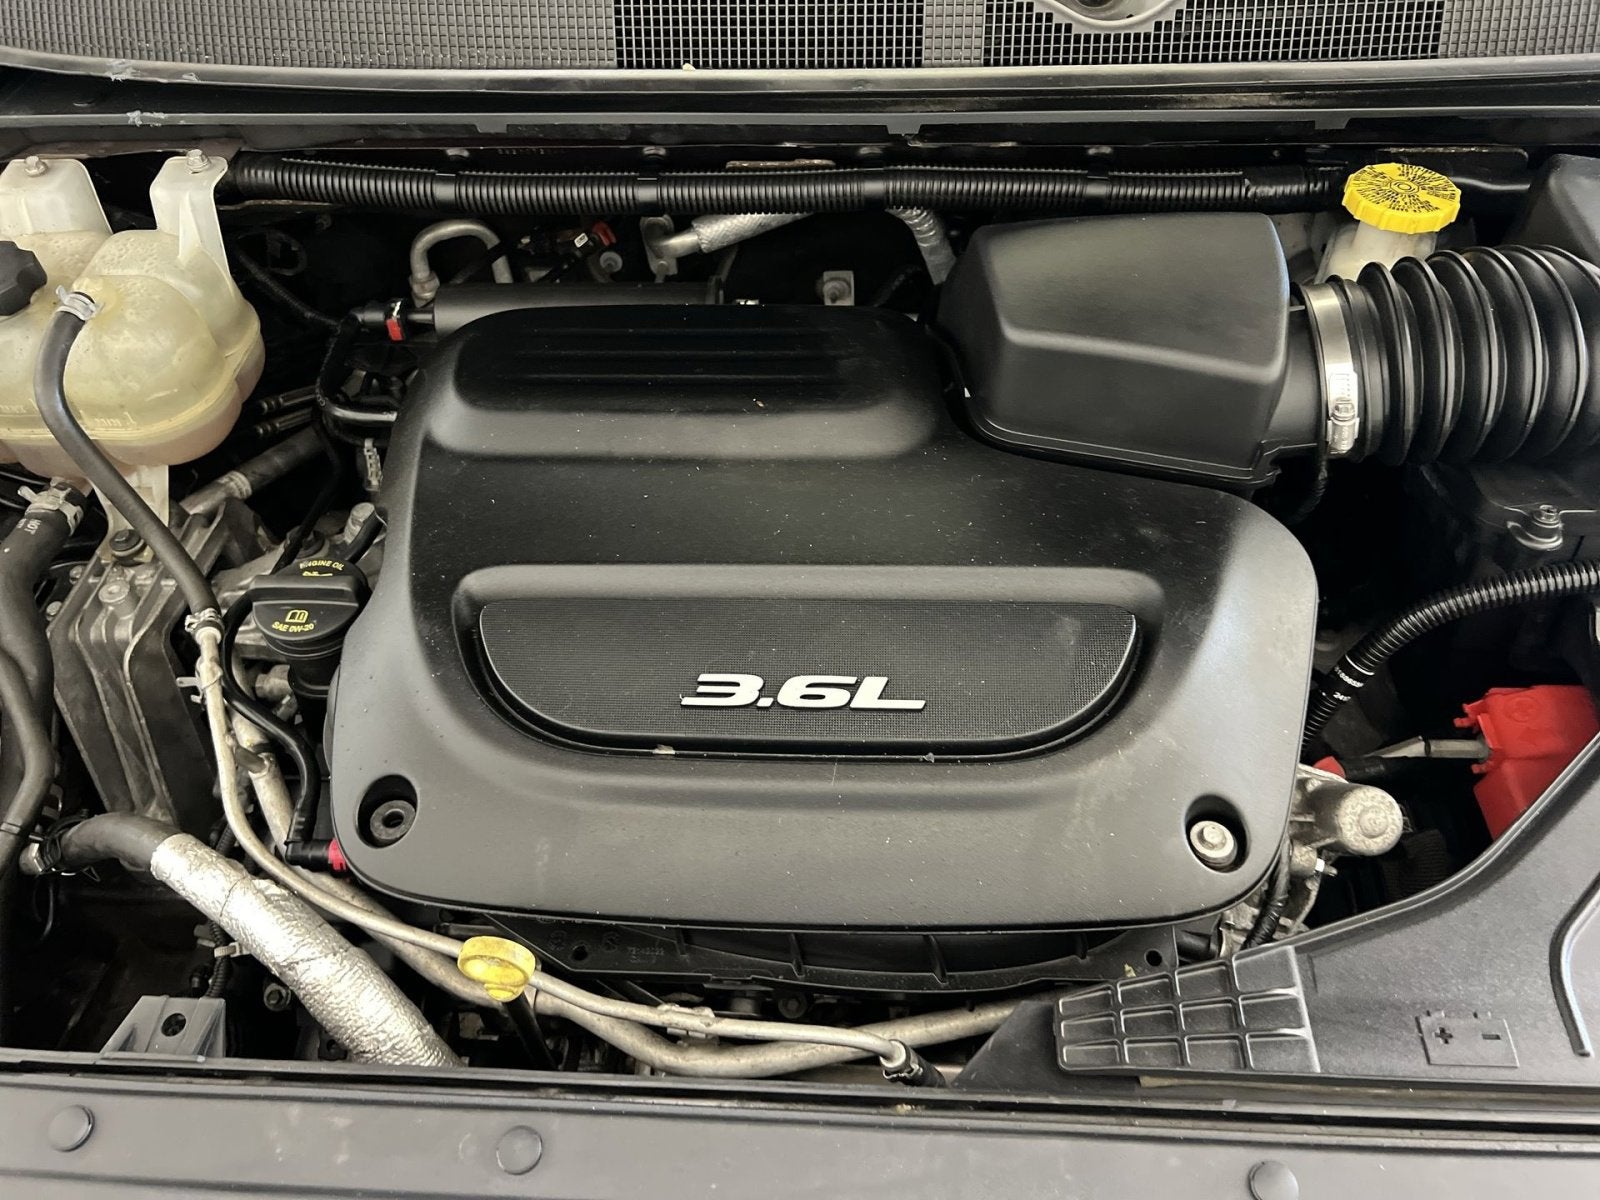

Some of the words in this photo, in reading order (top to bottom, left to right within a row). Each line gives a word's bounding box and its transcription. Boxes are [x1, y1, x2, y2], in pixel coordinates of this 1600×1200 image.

[300, 560, 332, 569] ENGINE
[332, 562, 344, 570] OIL
[271, 621, 289, 631] SAE
[680, 673, 926, 710] 3.6L
